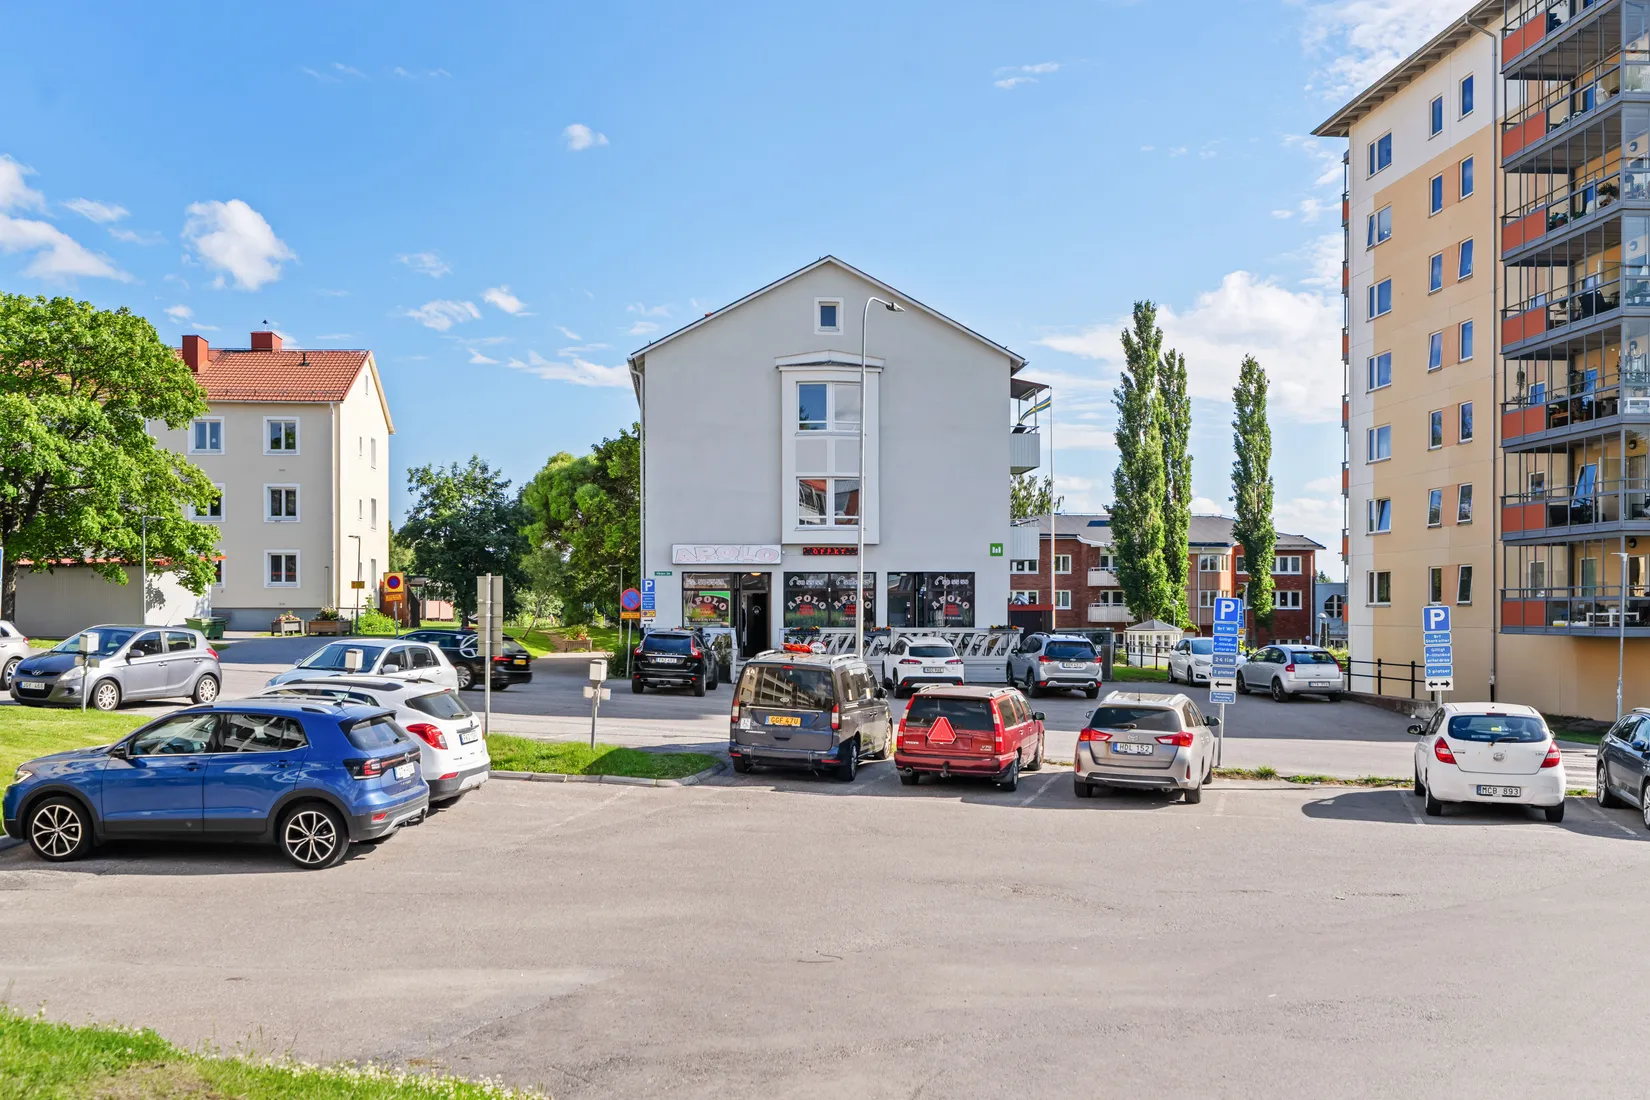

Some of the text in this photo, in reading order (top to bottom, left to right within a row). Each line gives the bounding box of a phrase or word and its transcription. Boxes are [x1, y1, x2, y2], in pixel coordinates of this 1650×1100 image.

[675, 545, 780, 563] APOLO
[645, 580, 653, 592] P
[787, 594, 827, 610] APOLO
[833, 594, 872, 610] APOO
[931, 594, 970, 610] APOLO
[1221, 600, 1235, 620] P
[1430, 609, 1445, 630] P
[1119, 743, 1150, 752] HDL 152
[1481, 786, 1519, 796] MCB 893
